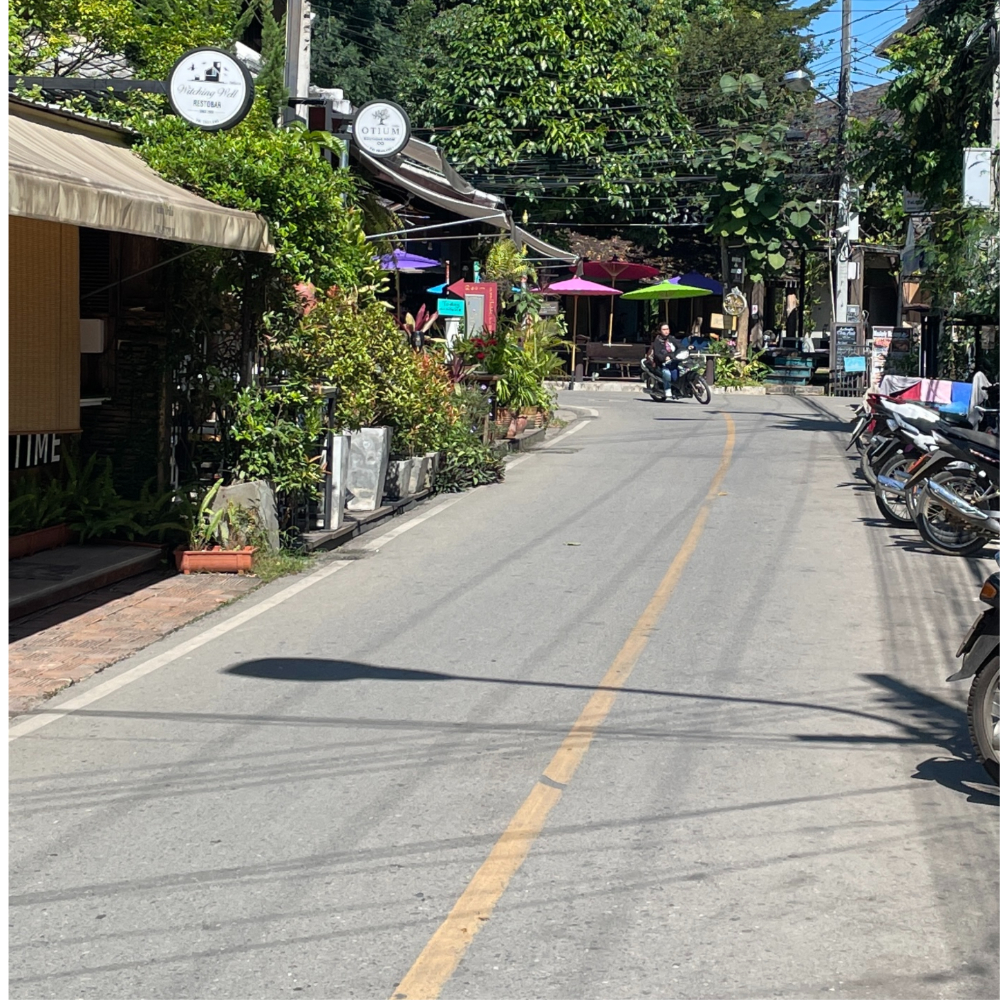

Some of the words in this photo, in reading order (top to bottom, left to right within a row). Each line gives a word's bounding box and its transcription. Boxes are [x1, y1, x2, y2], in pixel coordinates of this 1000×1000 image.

[177, 83, 216, 99] Witching
[217, 87, 240, 99] Well
[193, 100, 222, 109] RESTOBAR
[361, 127, 399, 135] OTIUM
